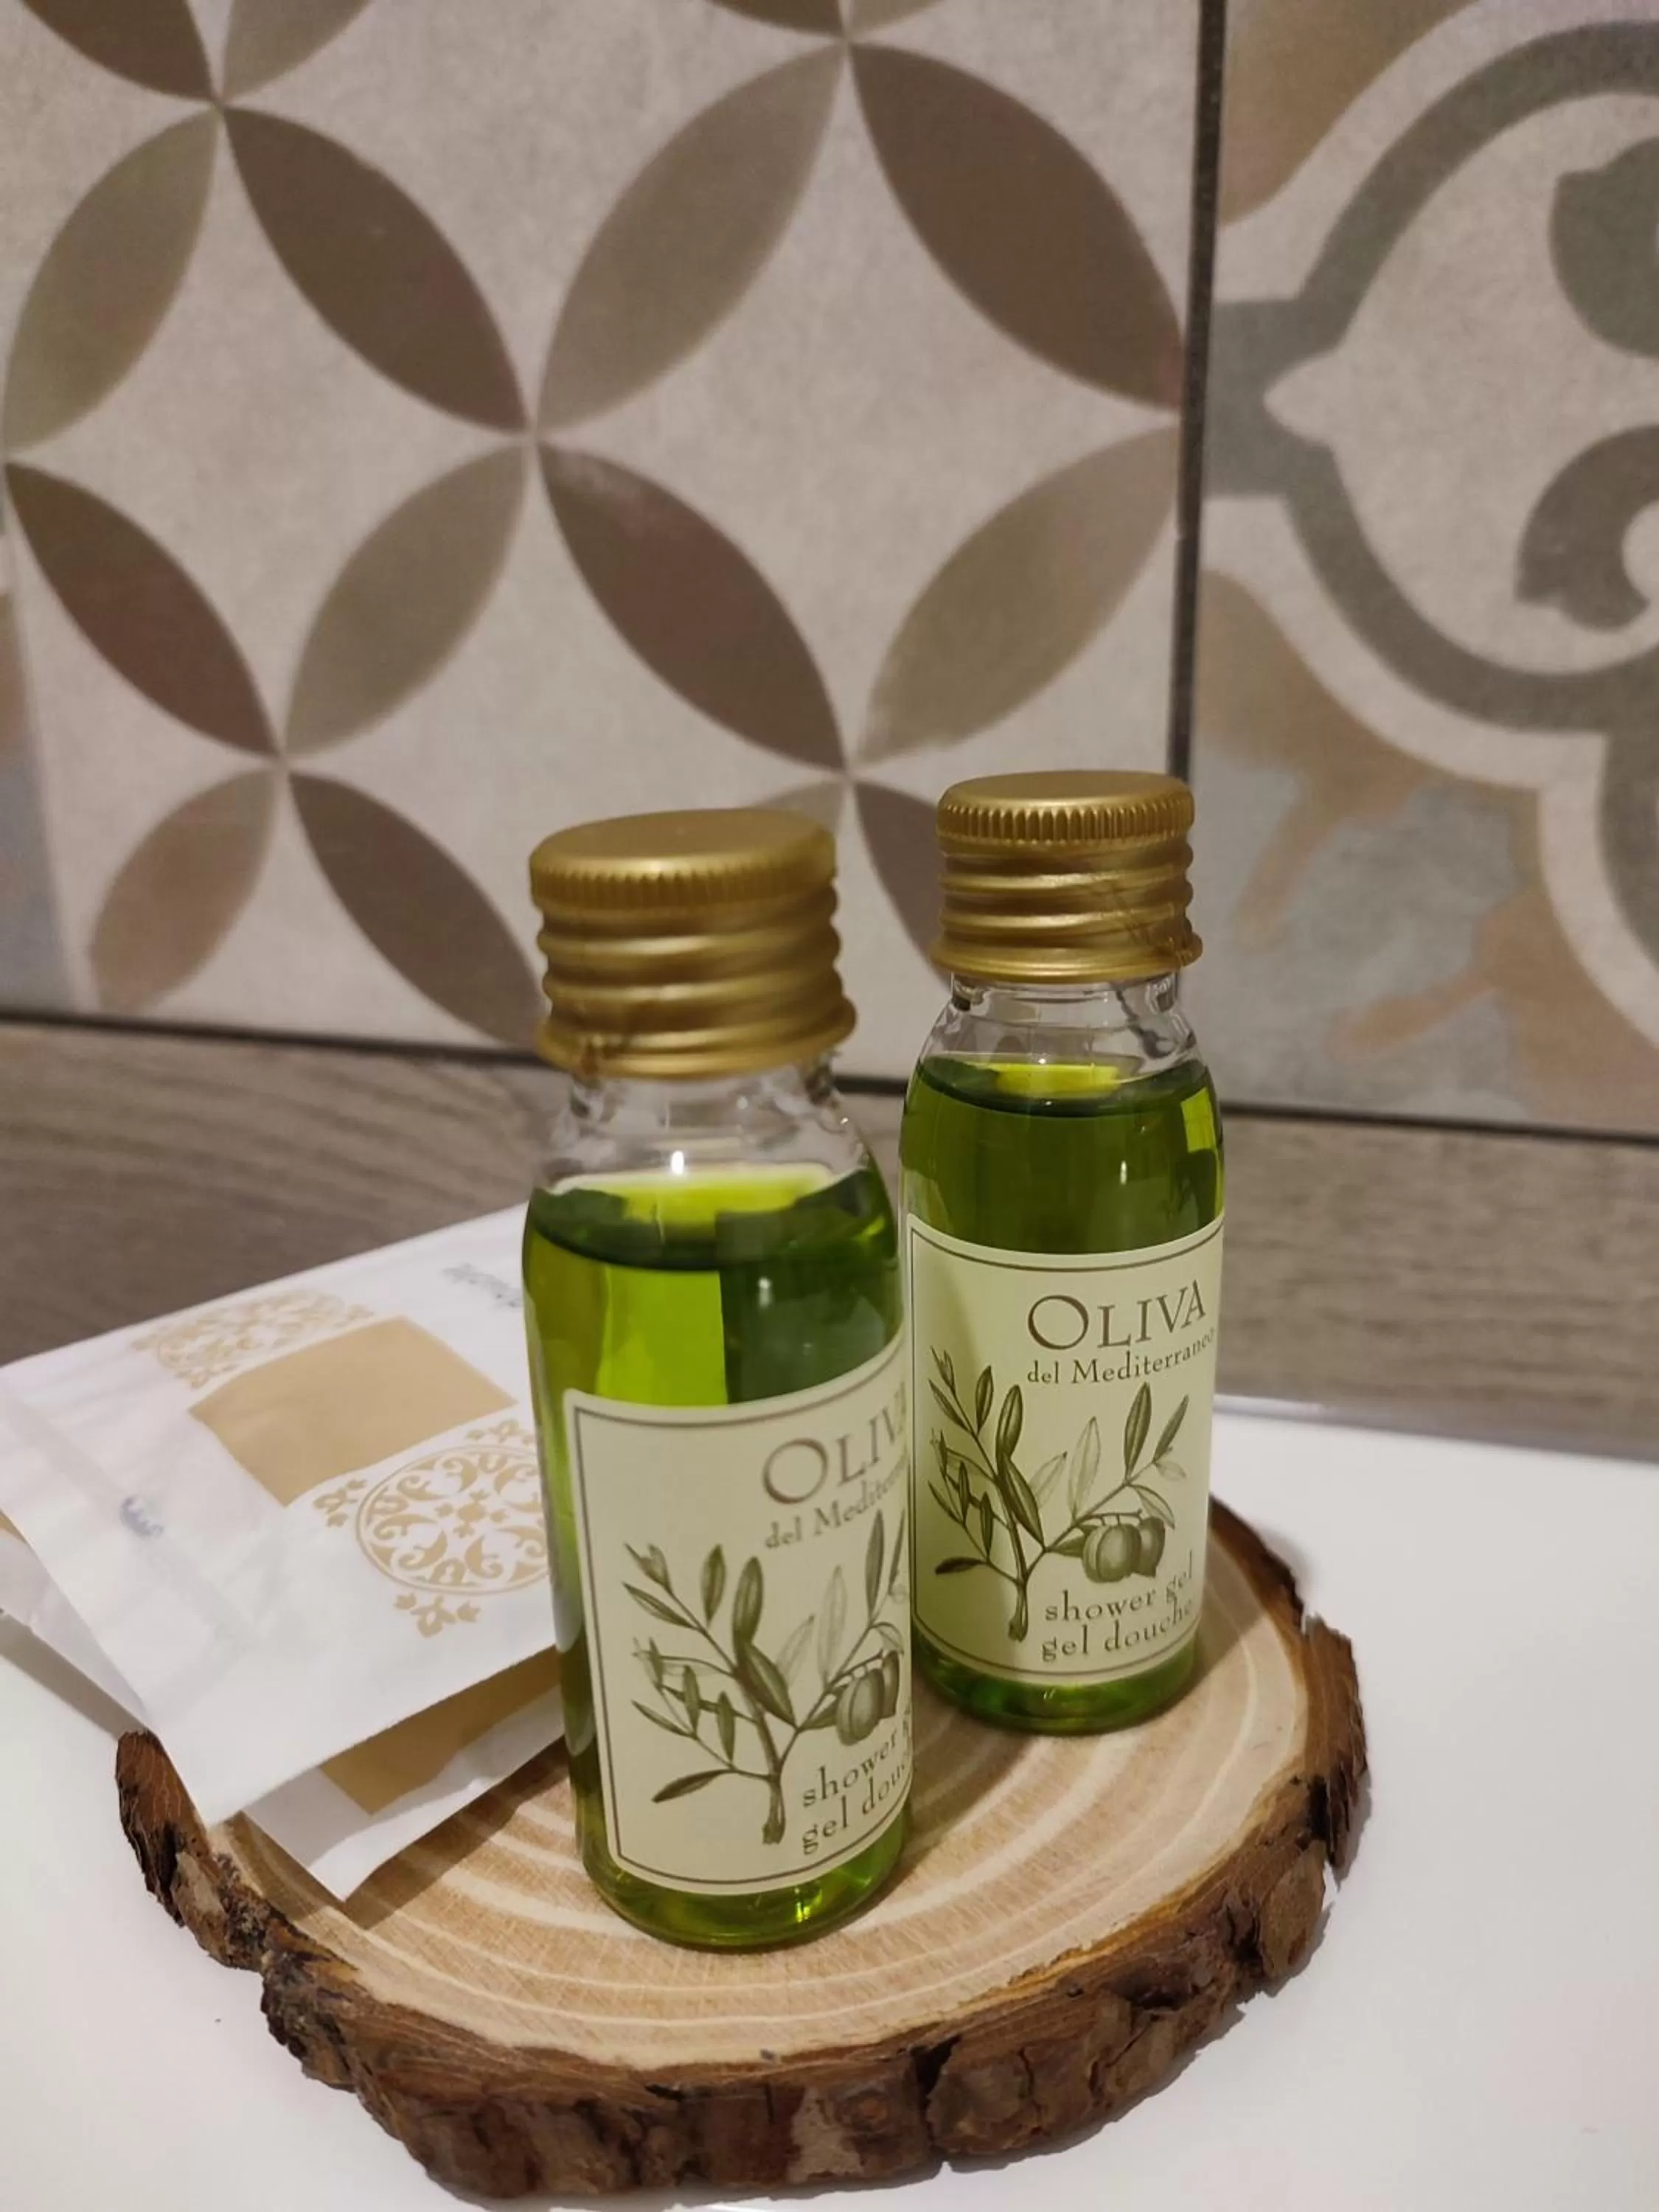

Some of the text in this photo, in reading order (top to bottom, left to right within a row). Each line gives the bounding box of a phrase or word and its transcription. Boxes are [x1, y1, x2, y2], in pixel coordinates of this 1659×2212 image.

[1027, 1279, 1206, 1350] OLIVA
[1027, 1326, 1215, 1384] del Mediterraneo
[764, 1515, 803, 1548] del
[1044, 1548, 1193, 1621] shower gel
[1041, 1598, 1192, 1663] gel douche
[802, 1727, 897, 1807] shower
[801, 1794, 849, 1855] gel
